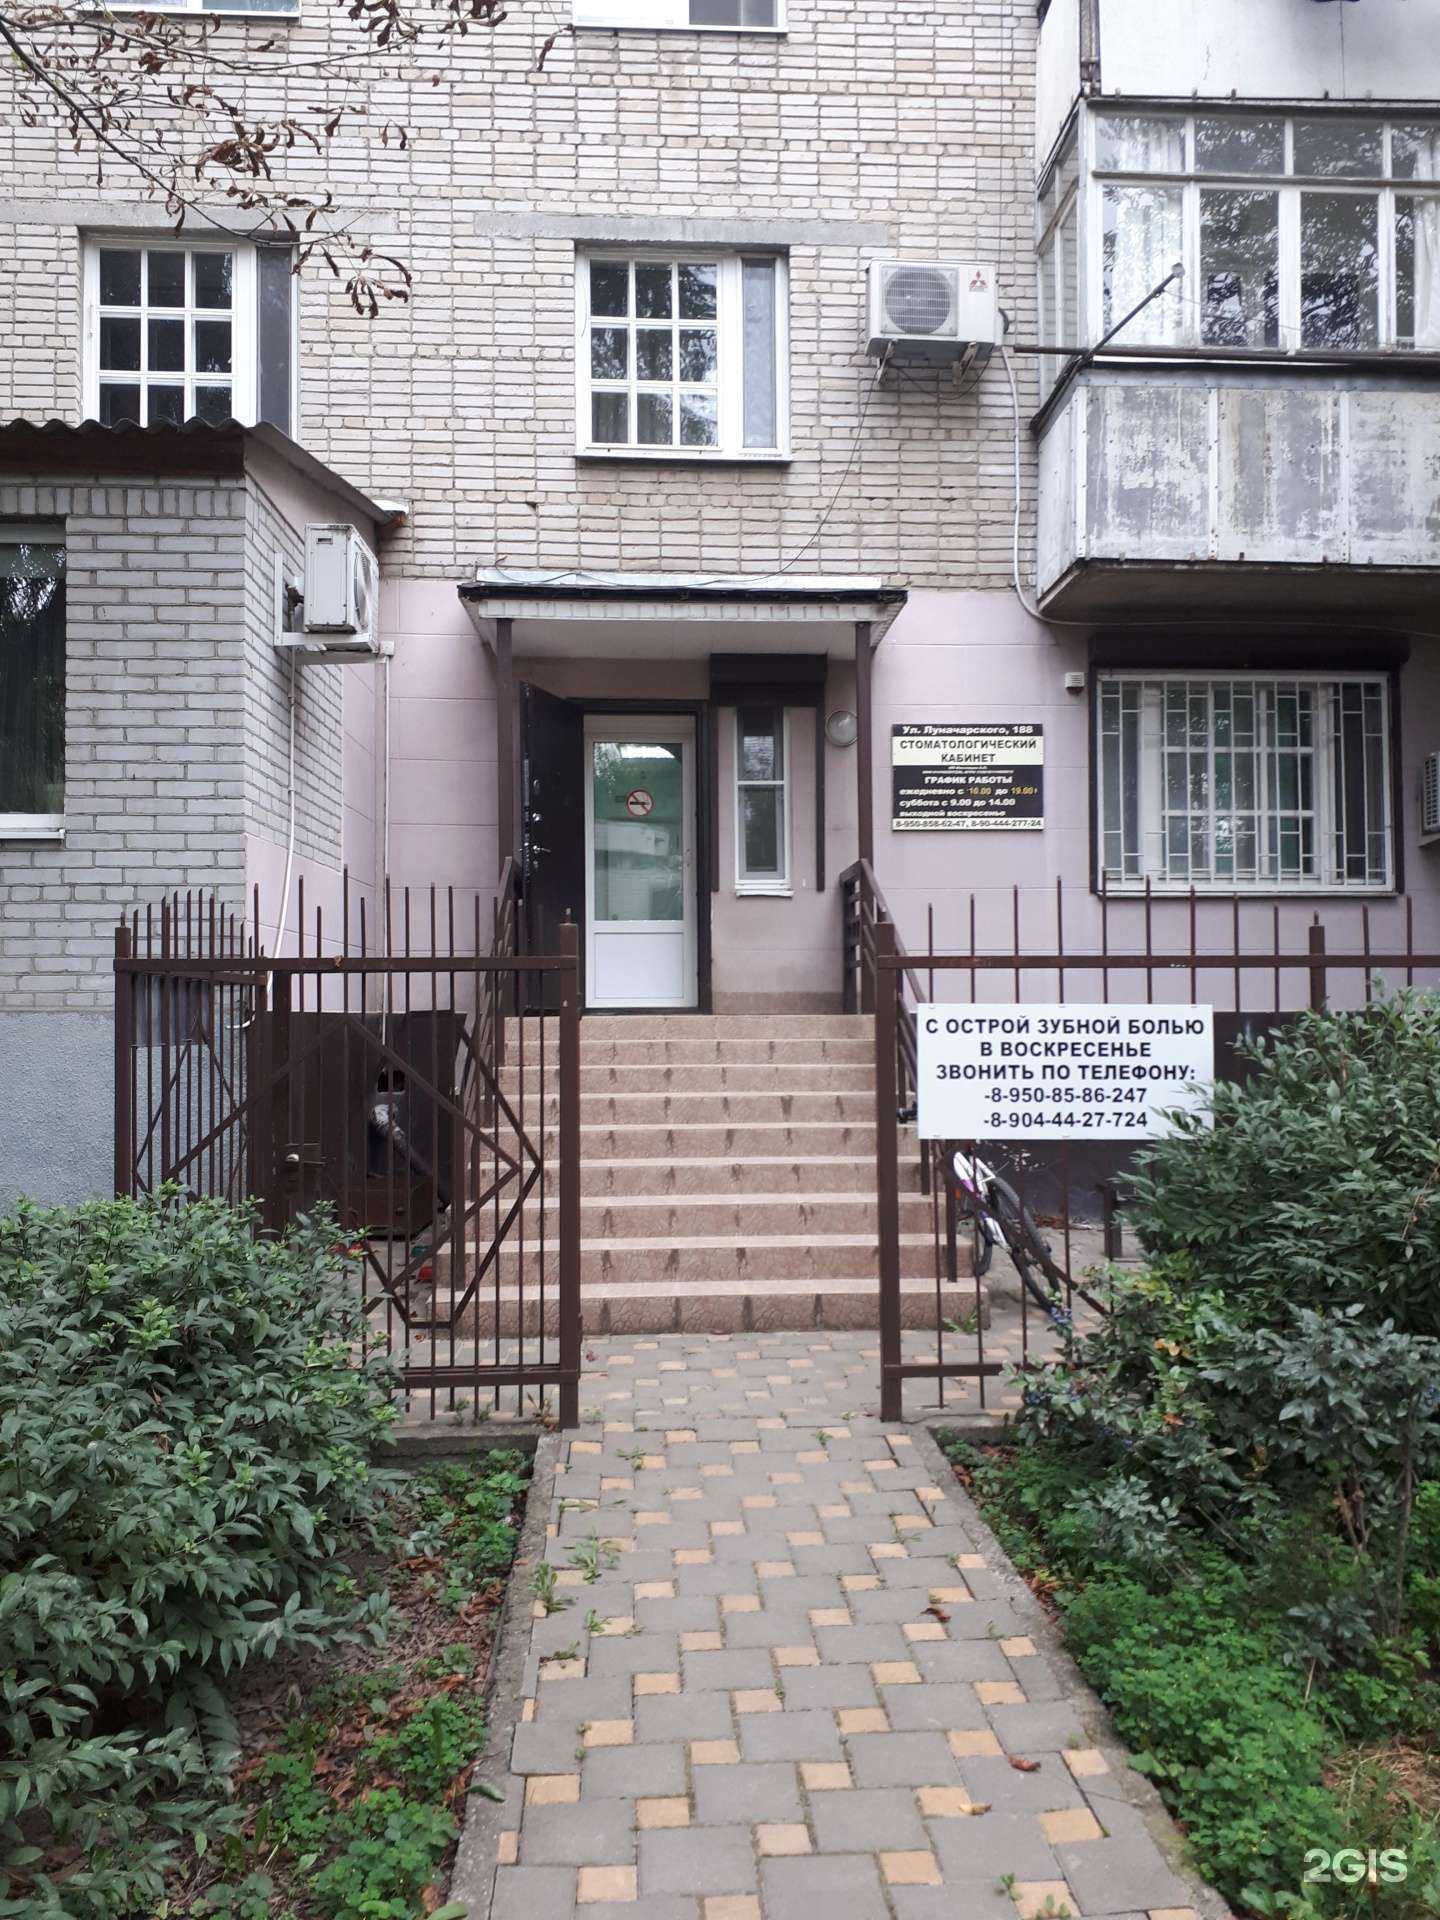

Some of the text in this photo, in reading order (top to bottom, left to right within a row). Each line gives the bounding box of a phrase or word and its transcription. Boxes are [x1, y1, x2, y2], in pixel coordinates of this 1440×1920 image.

[902, 725, 921, 735] Ул.
[1012, 725, 1033, 734] 188
[899, 738, 1037, 749] СТОМАТОЛОГИЧЕСКИЙ
[941, 753, 996, 763] КАБИНЕТ
[924, 776, 1013, 784] ГРАФИК РАБОТЫ
[899, 788, 956, 796] ежедневно
[995, 788, 1008, 796] до
[899, 798, 939, 807] суббота
[949, 798, 971, 807] 9.00
[988, 798, 1015, 806] 14.00
[946, 810, 1006, 818] воскресенье
[925, 1016, 1205, 1035] С ОСТРОЙ ЗУБНОЙ БОЛЬЮ
[980, 1042, 1152, 1057] В ВОСКРЕСЕНЬЕ
[936, 1064, 1196, 1080] ЗВОНИТЬ ПО ТЕЛЕФОНУ:
[984, 1087, 1147, 1103] -8-950-85-86-247
[983, 1112, 1148, 1128] -8-904-44-27-724
